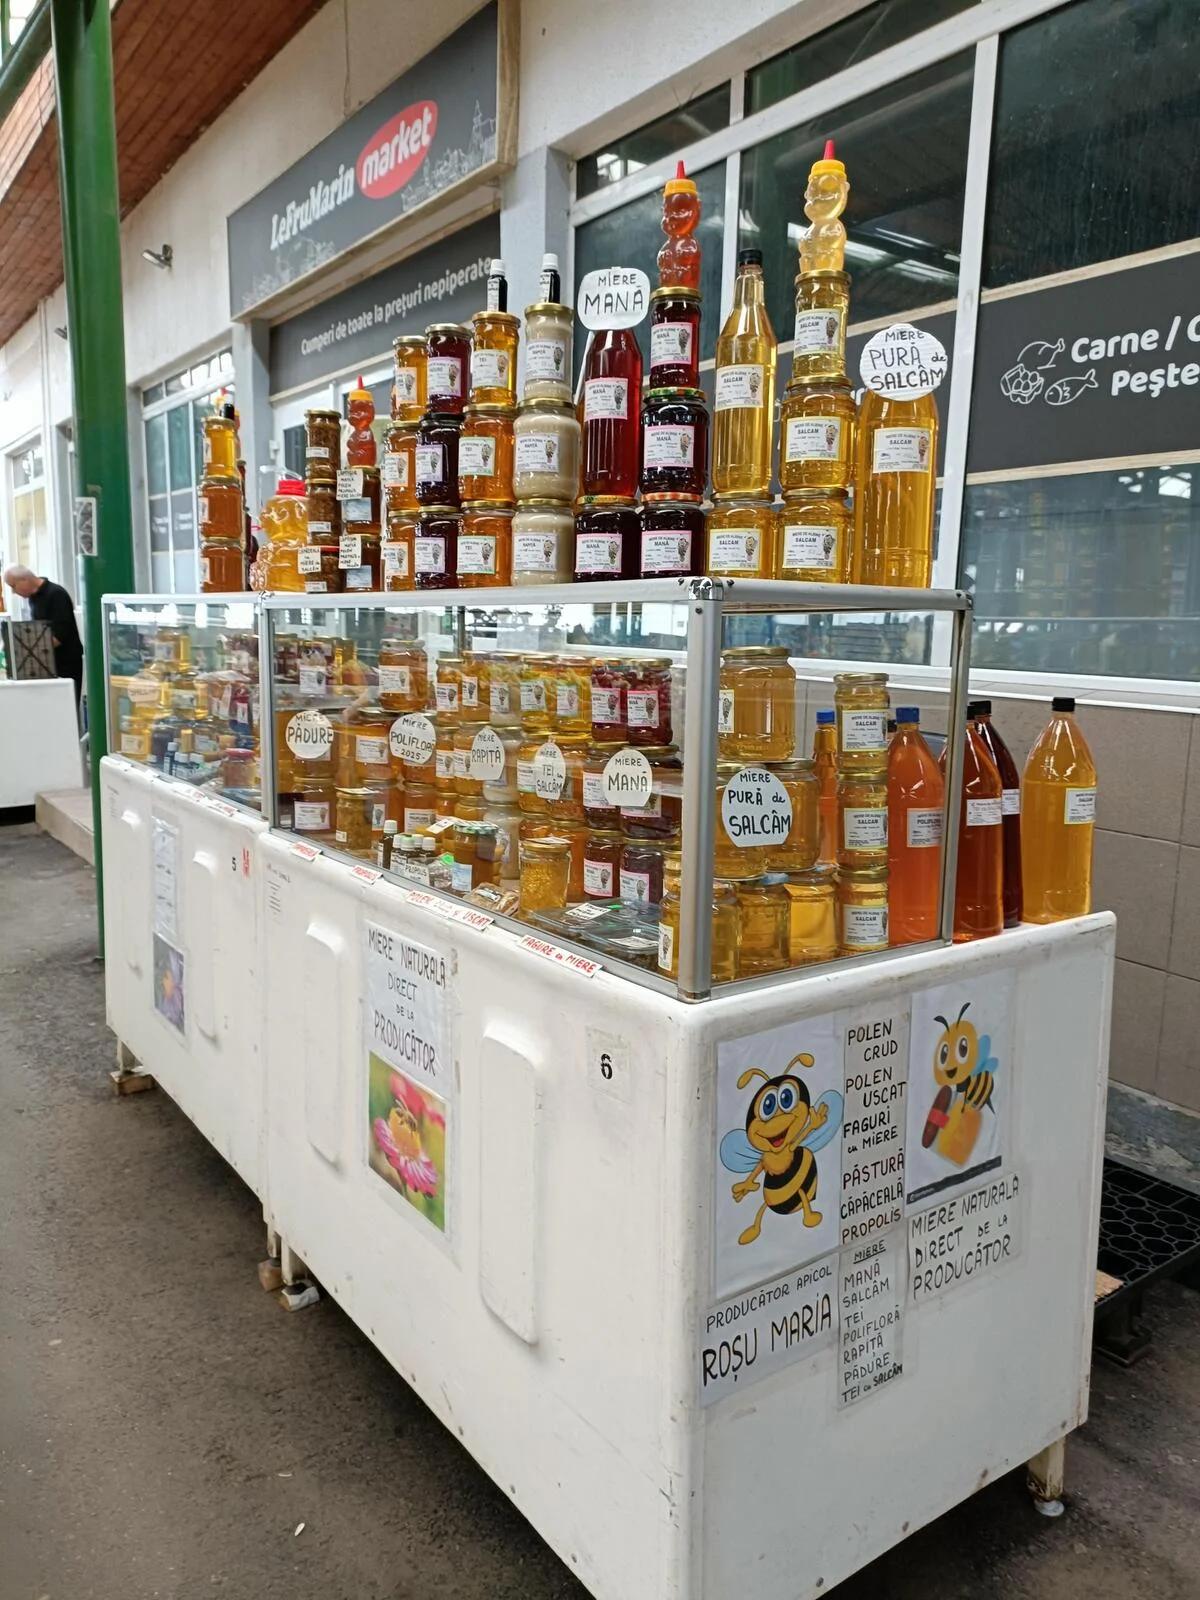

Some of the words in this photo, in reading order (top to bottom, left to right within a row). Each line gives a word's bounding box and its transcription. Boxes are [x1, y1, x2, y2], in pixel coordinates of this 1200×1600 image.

[361, 105, 432, 189] market
[270, 163, 355, 251] LeFruMarin
[598, 272, 637, 286] MIERE
[335, 320, 347, 341] de
[347, 310, 373, 333] toate
[373, 303, 384, 323] la
[423, 256, 492, 301] nepiperate
[584, 284, 643, 315] MANĂ
[885, 329, 926, 343] MIERE
[1070, 328, 1160, 363] Carne
[869, 342, 921, 370] PURĂ
[930, 351, 947, 363] de
[870, 364, 944, 391] SALCÂM
[287, 722, 333, 744] PĂDURE
[614, 755, 642, 767] MIERE
[739, 770, 771, 783] MIERE
[607, 770, 648, 792] MANĂ
[728, 787, 763, 806] PURĂ
[771, 791, 786, 803] de
[728, 809, 791, 837] SALCÂM
[368, 927, 394, 961] MIERE
[400, 942, 446, 989] NATURALĂ
[521, 936, 557, 956] FAGURE
[566, 954, 597, 973] MIERE
[387, 972, 418, 1002] DIRECT
[396, 1004, 405, 1017] DE
[406, 1008, 415, 1022] LA
[373, 1009, 436, 1077] PRODUCĂTOR
[847, 1018, 893, 1046] POLEN
[863, 1039, 898, 1062] CRUD
[600, 1053, 613, 1080] 6
[845, 1066, 893, 1094] POLEN
[863, 1081, 907, 1108] USCAT
[843, 1105, 890, 1139] FAGURI
[862, 1125, 899, 1149] MIERE
[843, 1147, 905, 1190] PĂSTURĂ
[840, 1176, 904, 1220] CĂPĂCEALĂ
[841, 1206, 902, 1245] PROPOLIS
[911, 1201, 957, 1239] MIERE
[854, 1239, 886, 1261] MIERE
[915, 1226, 964, 1268] DIRECT
[977, 1221, 990, 1237] DE
[997, 1214, 1008, 1227] LA
[844, 1259, 881, 1292] MANĂ
[913, 1233, 1011, 1300] PRODUCĂTOR
[706, 1282, 790, 1334] PRODUCĂTOR
[796, 1265, 832, 1290] APICOL
[842, 1277, 890, 1308] SALCÂM
[843, 1304, 900, 1346] POLIFLORĂ
[844, 1306, 864, 1328] TEI
[702, 1327, 758, 1387] ROȘU
[771, 1292, 832, 1352] MARIA
[843, 1332, 884, 1365] RAPIȚĂ
[841, 1387, 860, 1403] TEI
[872, 1362, 903, 1388] SALCÂM
[844, 1351, 891, 1386] PĂDURE
